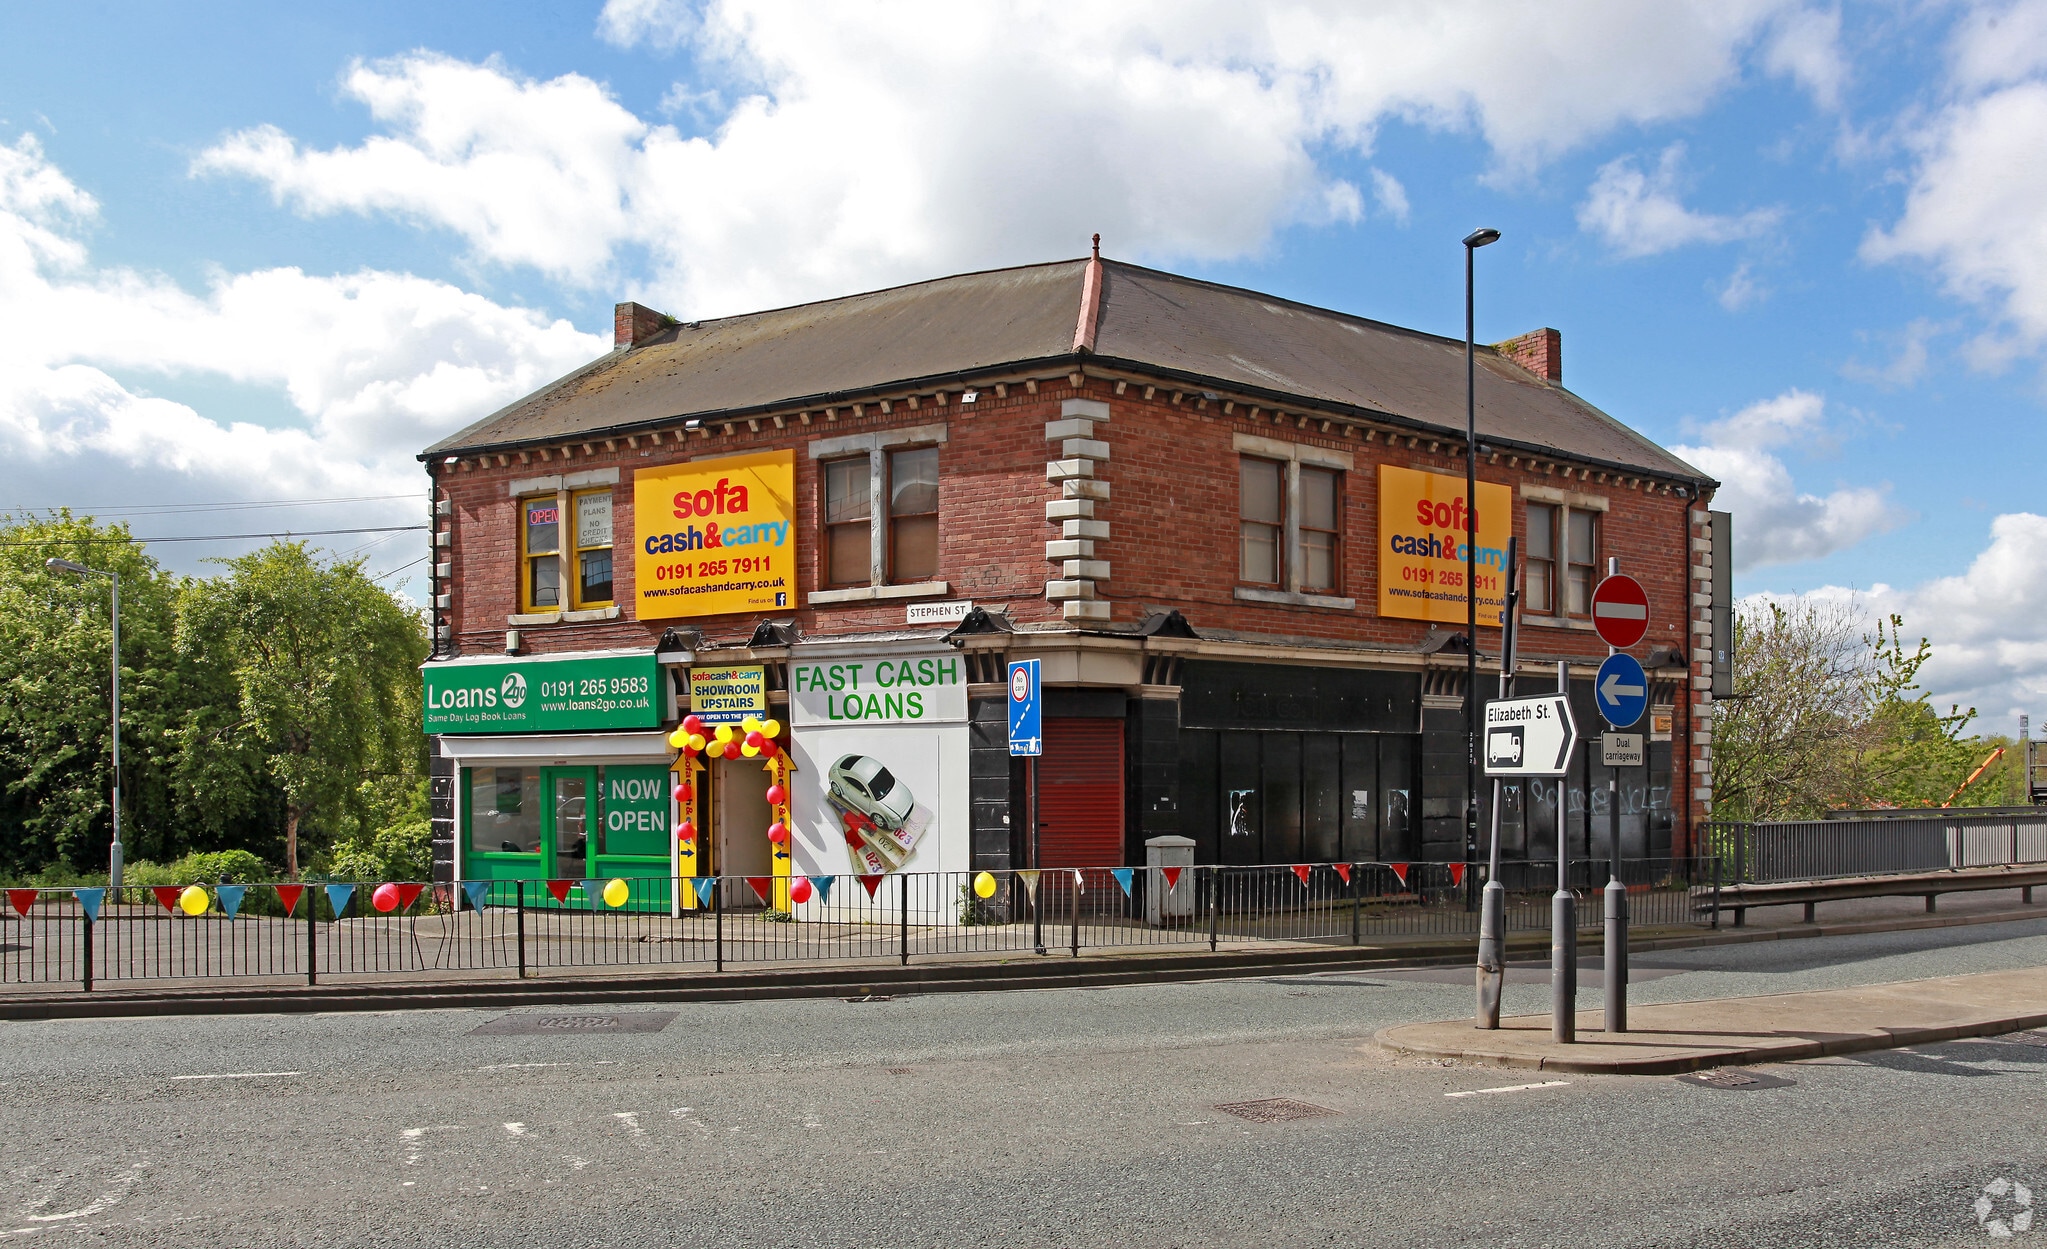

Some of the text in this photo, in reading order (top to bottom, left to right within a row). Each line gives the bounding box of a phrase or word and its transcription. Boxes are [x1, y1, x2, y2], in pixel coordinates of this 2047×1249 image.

[580, 495, 611, 506] PAYMENT
[673, 477, 748, 519] sofa
[530, 508, 559, 524] OPEN
[583, 507, 606, 516] PLANS
[1416, 496, 1480, 533] sofa
[582, 528, 607, 537] CREDIT
[645, 519, 790, 555] cash&carry
[1391, 533, 1508, 572] cash&crry
[656, 555, 770, 581] 0191 265 7911
[1402, 566, 1497, 591] 0191 265 911
[643, 577, 785, 598] www.sofacashandcarry.co.uk
[910, 604, 968, 618] STEPHEN ST.
[795, 658, 957, 692] FAST CASH
[428, 674, 527, 709] Loans 2go
[541, 677, 649, 698] 0191 265 9583
[695, 684, 760, 696] SHOWROOM
[541, 697, 650, 712] www.loans2go.co.uk
[701, 697, 754, 709] UPSTAIRS
[828, 692, 924, 720] LOANS
[1488, 704, 1551, 722] Elizabeth St.
[428, 711, 527, 724] Same Day Log Book Loans
[1616, 737, 1630, 748] Dual
[777, 753, 785, 778] sofa
[1605, 750, 1641, 763] carriageway
[612, 779, 662, 800] NOW
[608, 810, 665, 832] OPEN
[865, 851, 883, 873] £20
